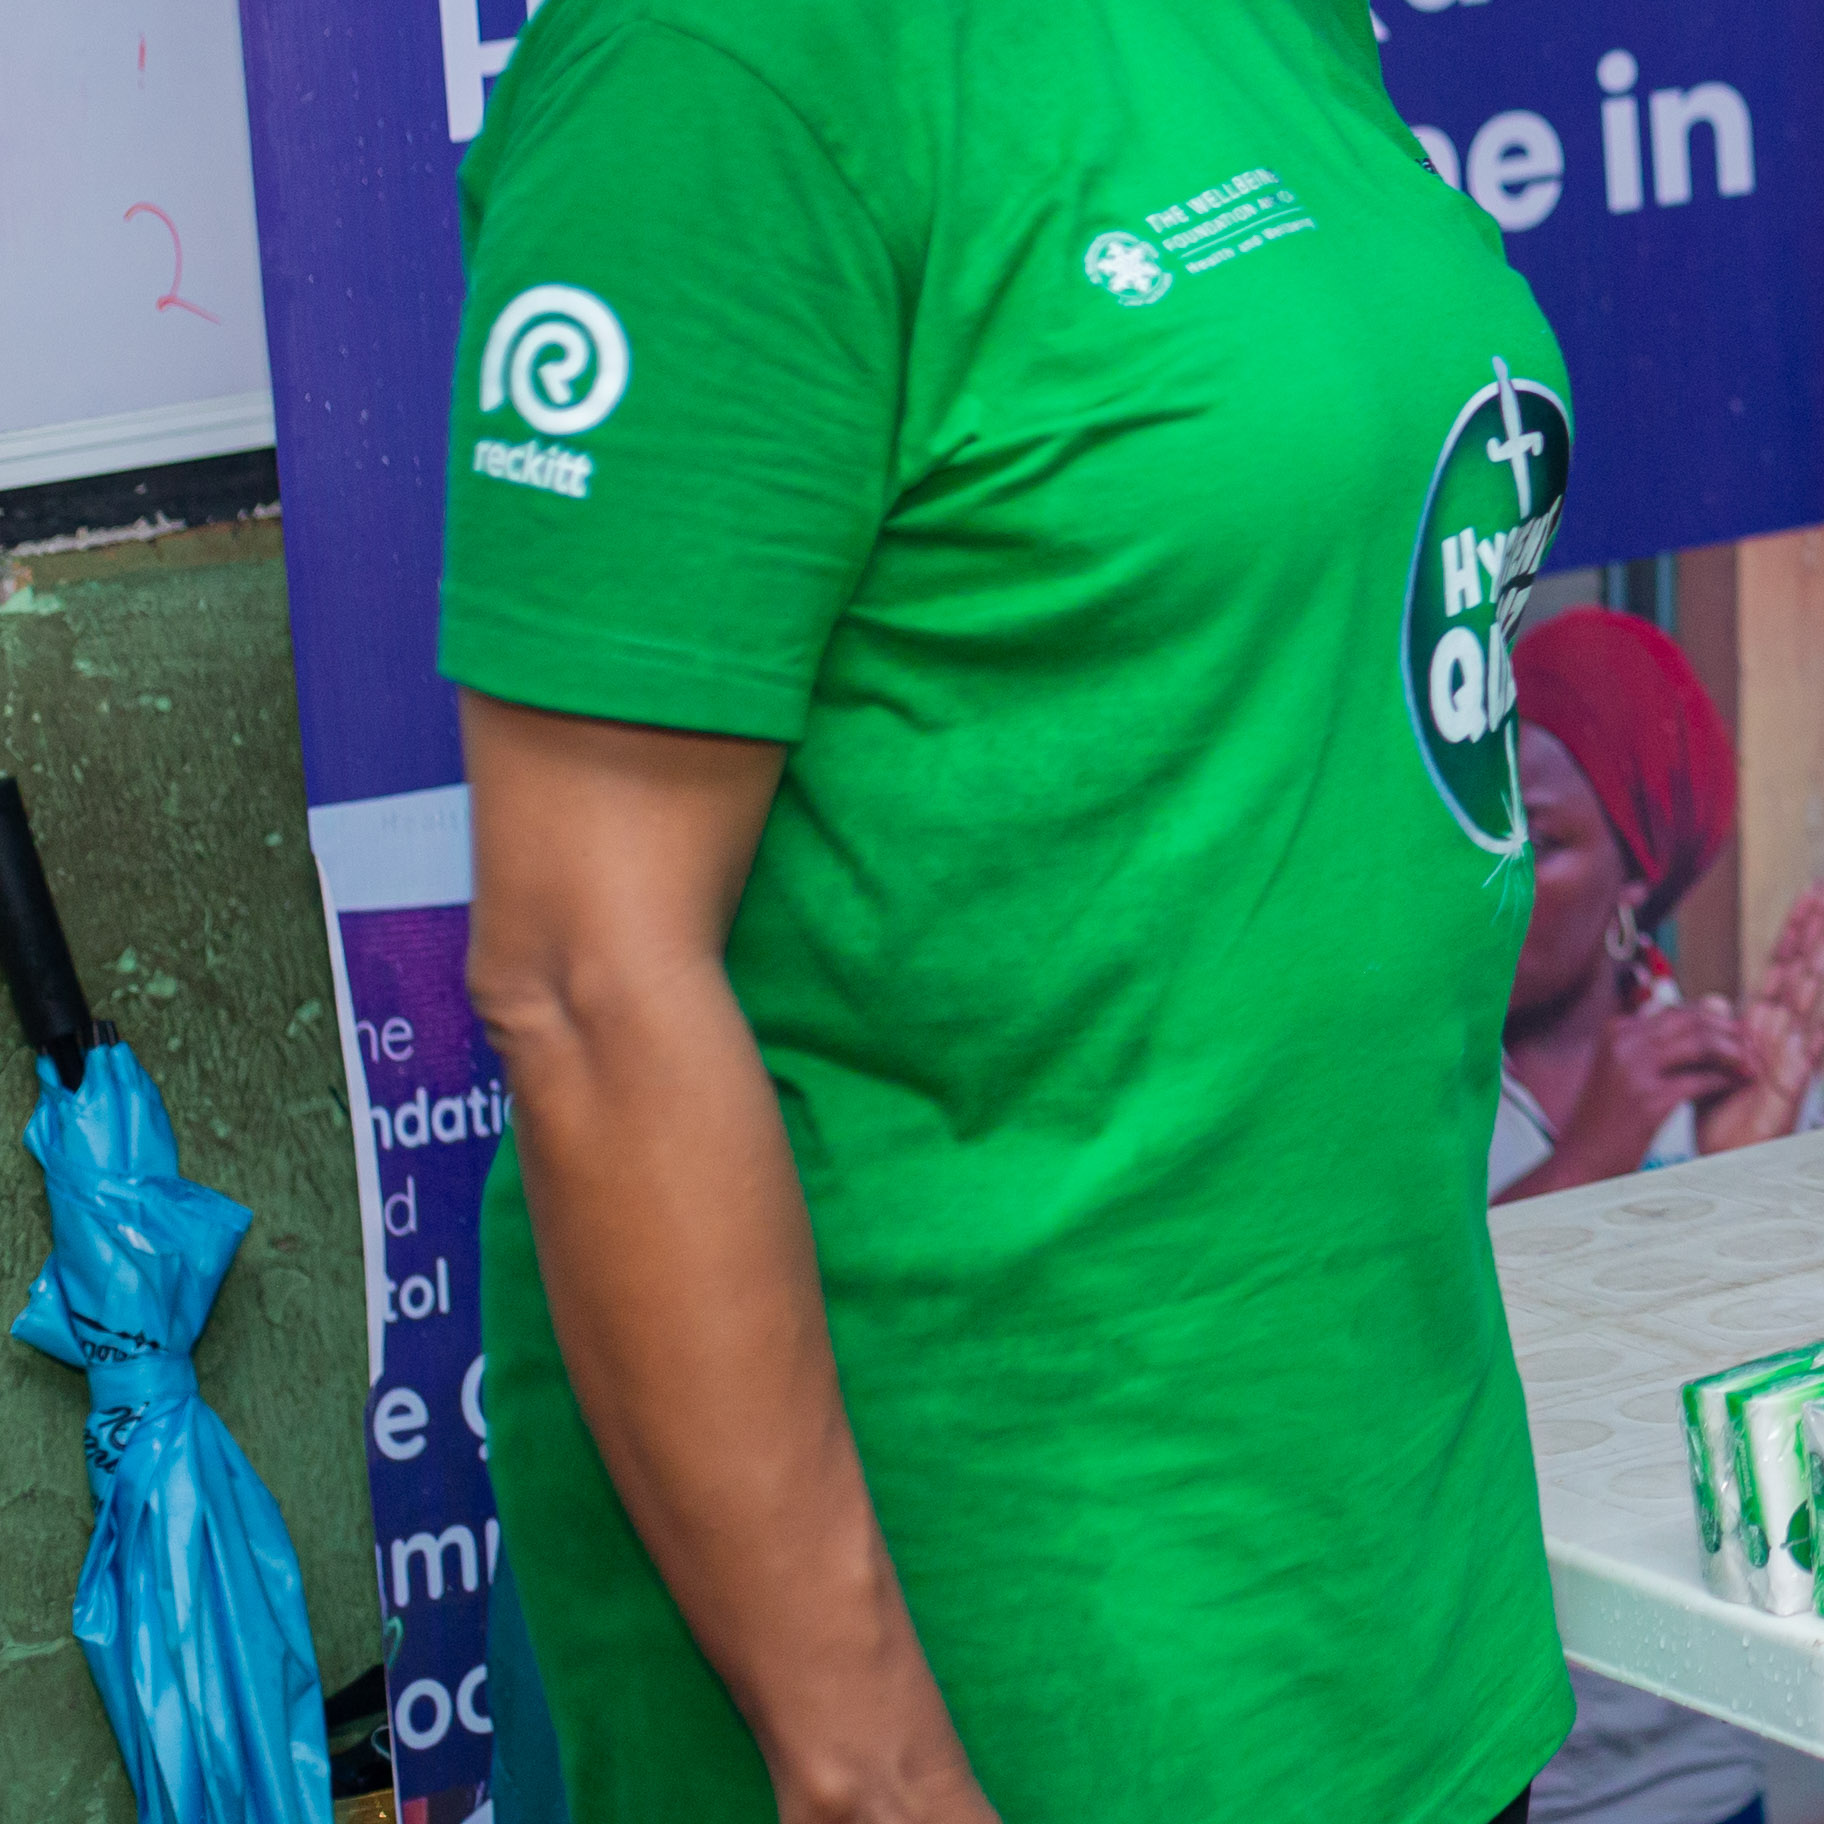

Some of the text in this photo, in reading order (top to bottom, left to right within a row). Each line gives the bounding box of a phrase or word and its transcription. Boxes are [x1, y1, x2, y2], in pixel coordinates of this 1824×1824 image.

[1595, 48, 1757, 216] in
[1186, 168, 1280, 215] WELLBEIN
[473, 437, 594, 499] reckitt
